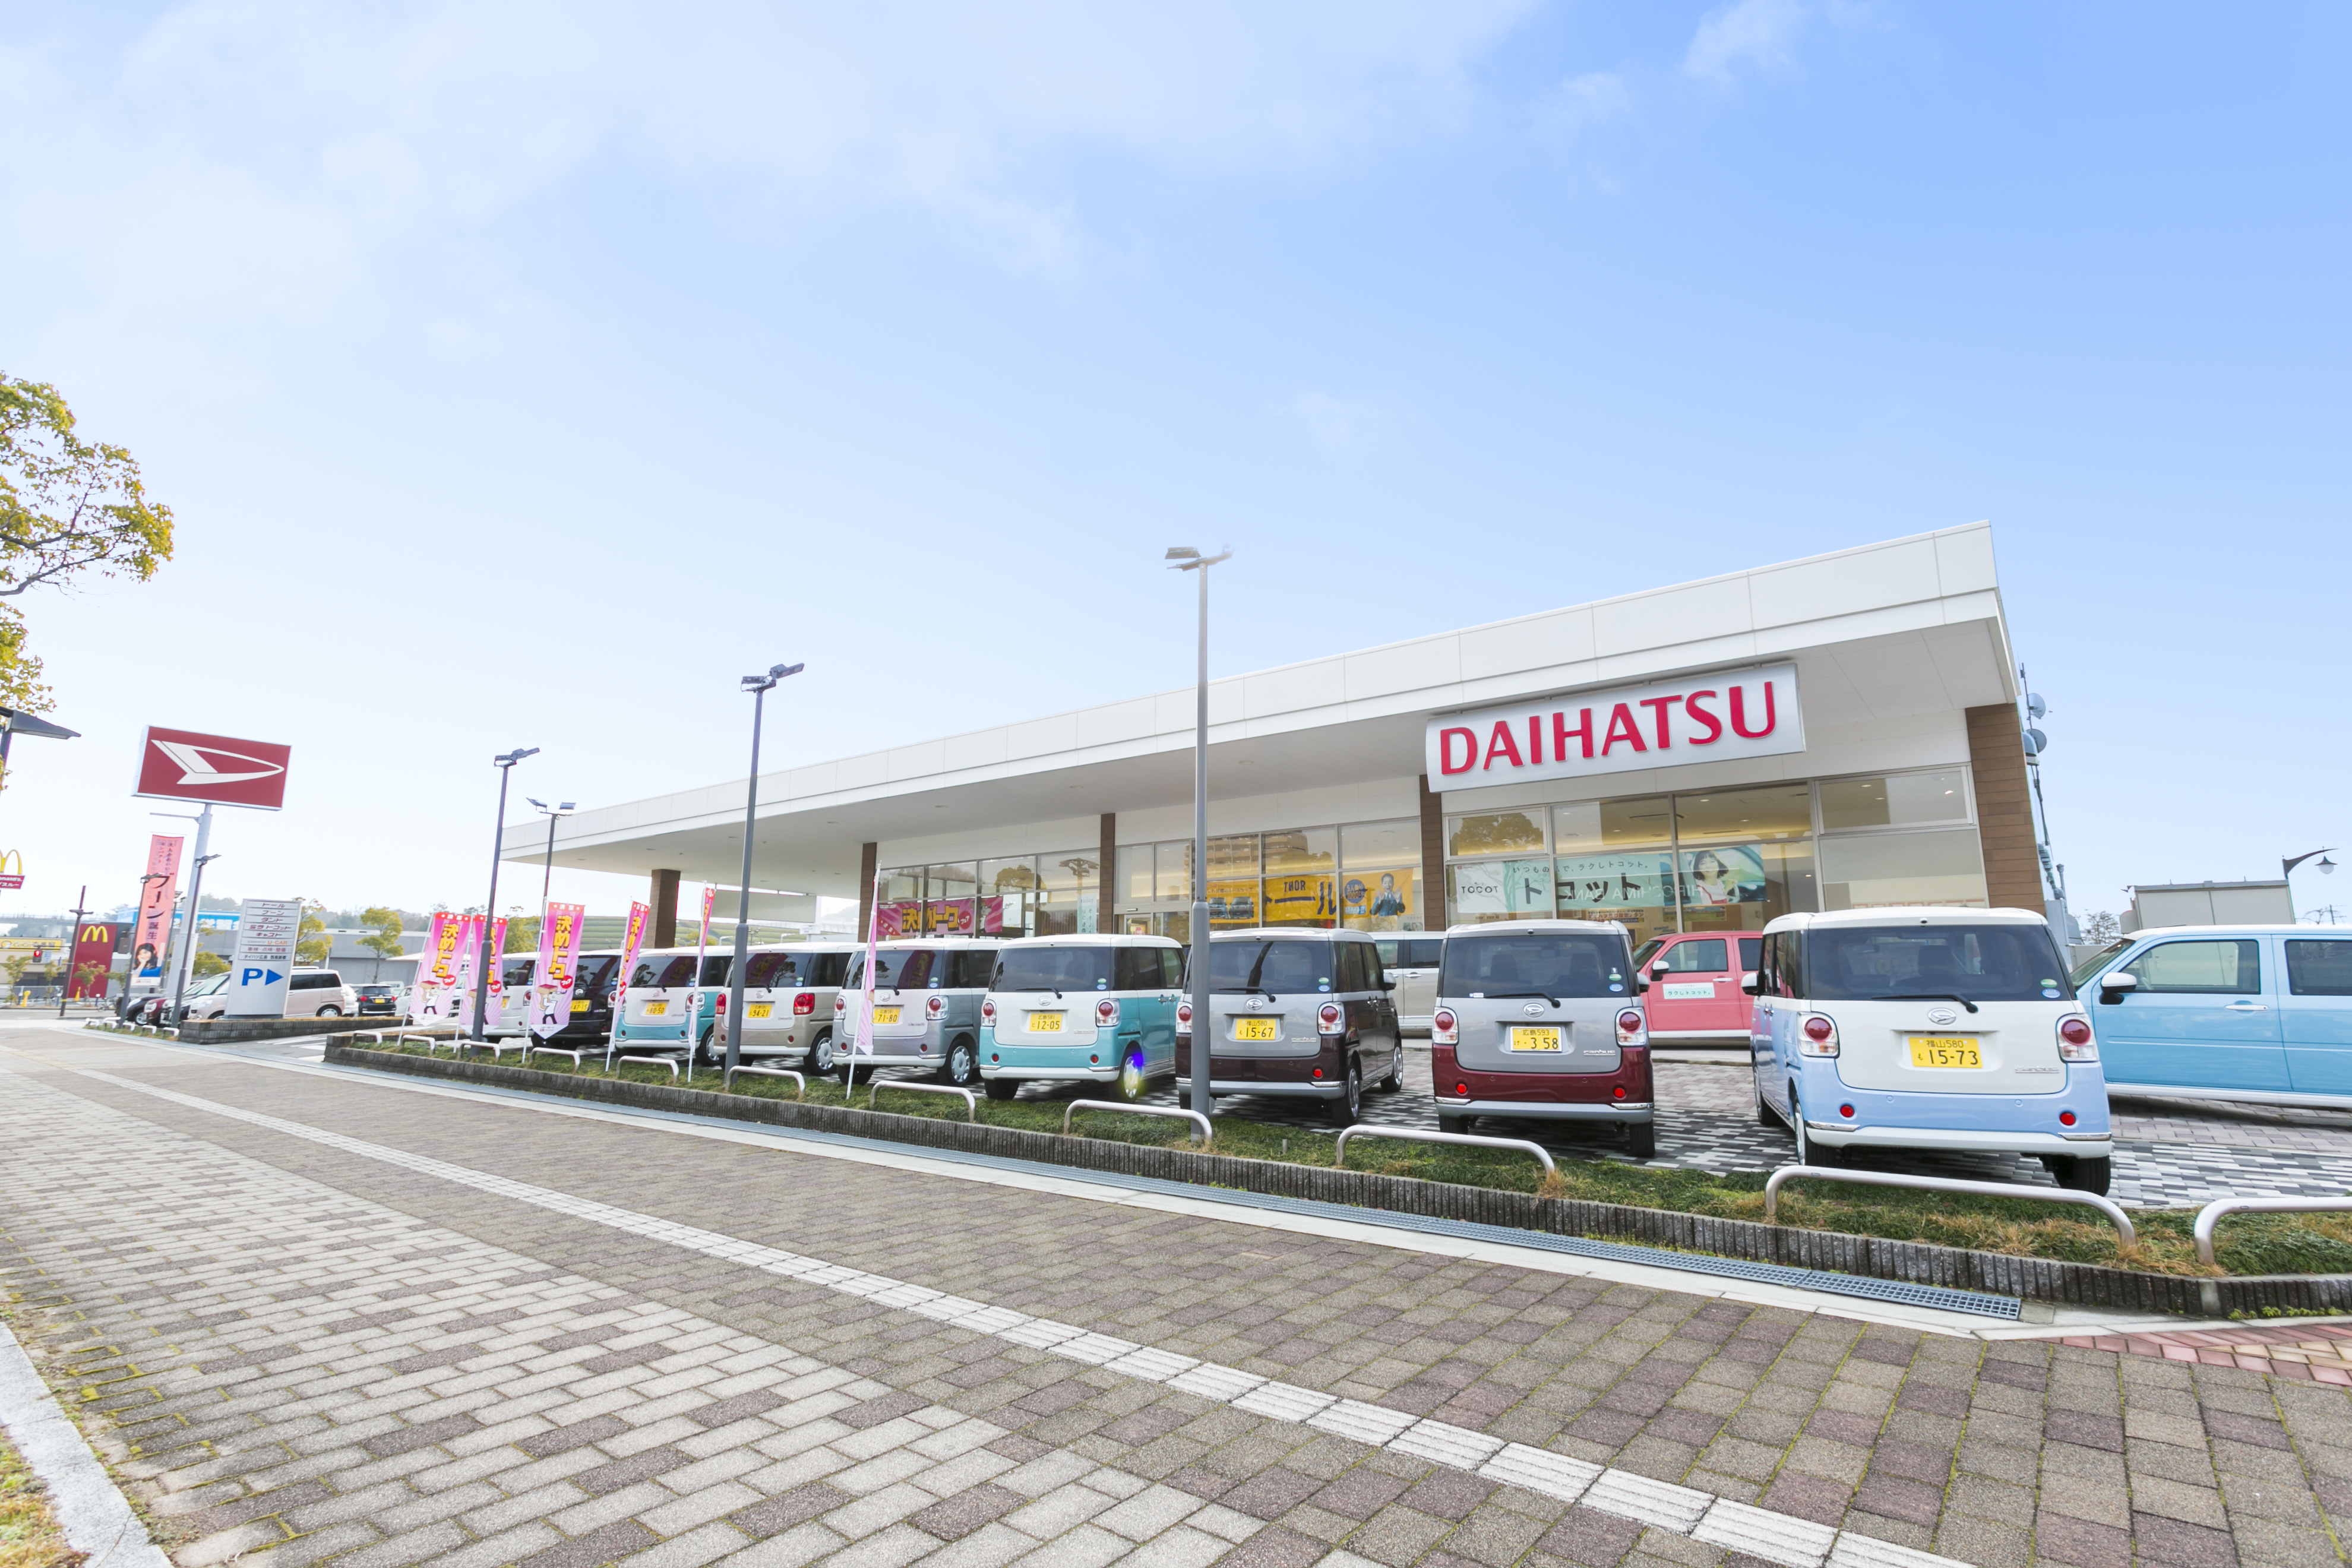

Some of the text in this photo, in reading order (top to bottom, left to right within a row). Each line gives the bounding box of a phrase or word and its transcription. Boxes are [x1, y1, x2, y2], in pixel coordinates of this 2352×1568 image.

[1439, 681, 1776, 776] DAIHATSU
[1284, 880, 1306, 892] THOR
[1462, 886, 1499, 894] TOCOT
[1524, 872, 1641, 904] トコット
[432, 923, 460, 978] 決めトク
[548, 915, 573, 980] 決めトク
[242, 968, 264, 986] P
[1037, 1020, 1060, 1029] 12-05
[1246, 1028, 1273, 1038] 15-67
[1929, 1049, 1978, 1066] 15-73
